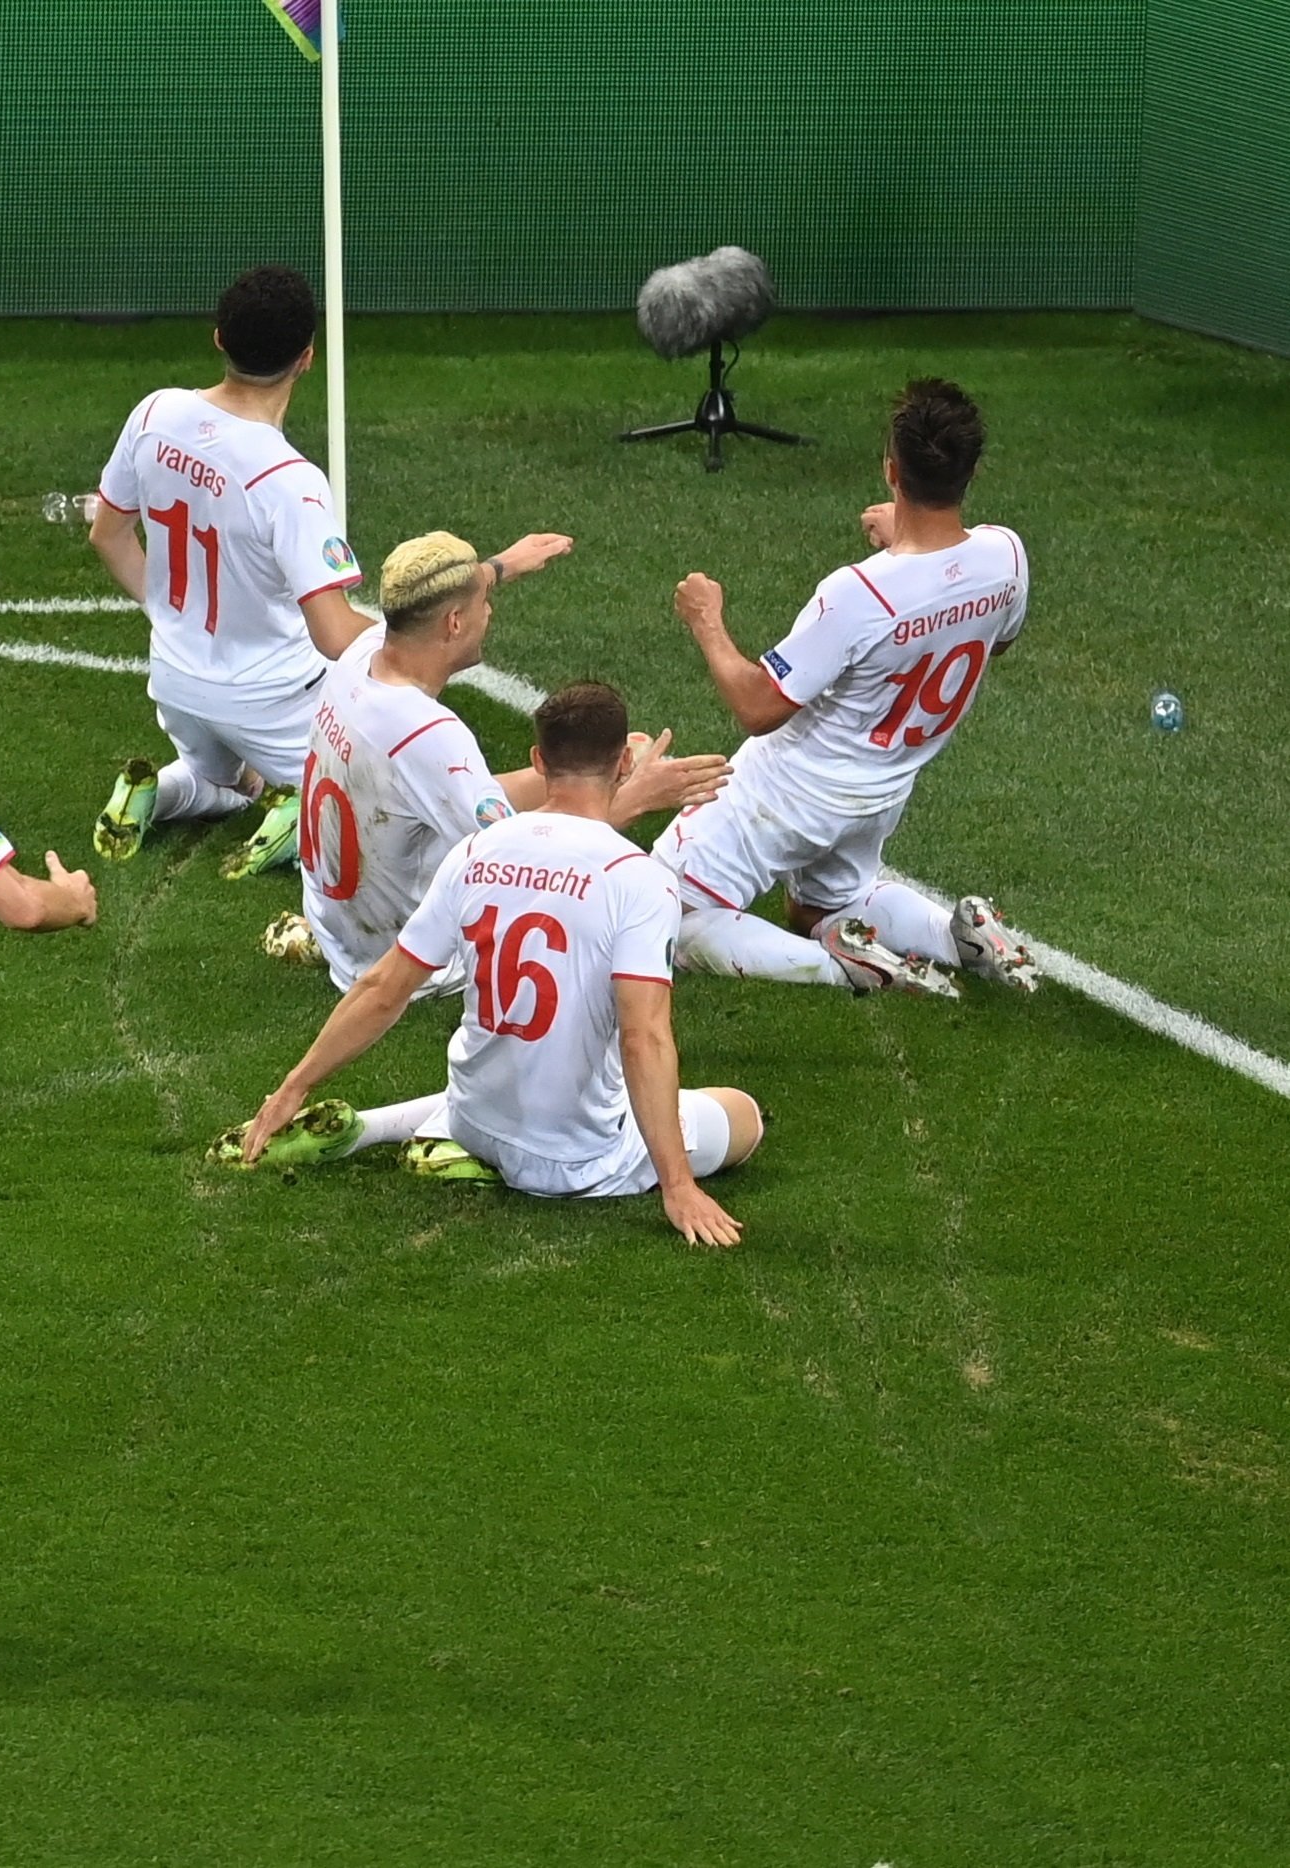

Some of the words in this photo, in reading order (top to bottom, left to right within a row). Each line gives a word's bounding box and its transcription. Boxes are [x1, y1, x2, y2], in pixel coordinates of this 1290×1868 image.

[156, 440, 226, 498] vargas
[148, 498, 218, 636] 11
[893, 583, 1017, 644] gavranovic
[315, 700, 352, 765] xhaka
[870, 640, 985, 748] 19
[461, 904, 568, 1042] 16
